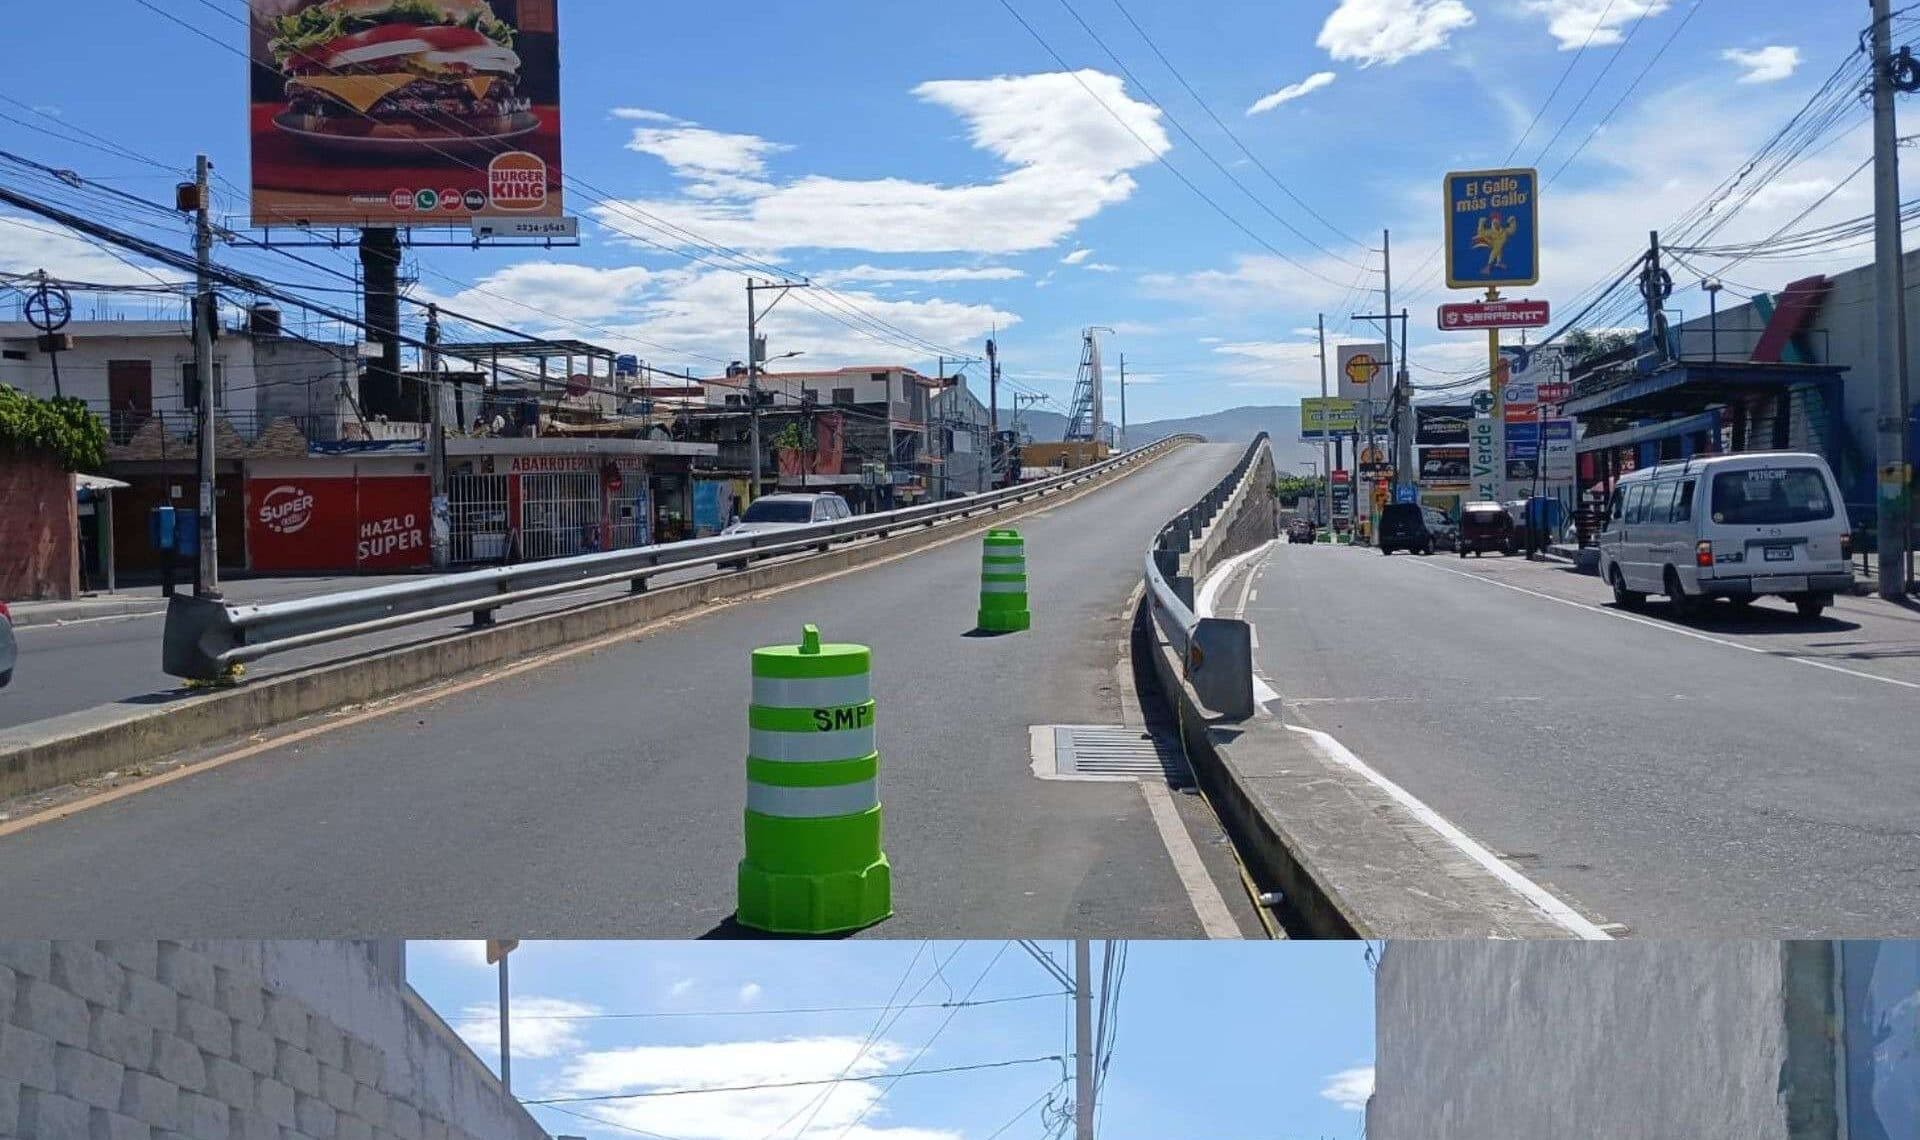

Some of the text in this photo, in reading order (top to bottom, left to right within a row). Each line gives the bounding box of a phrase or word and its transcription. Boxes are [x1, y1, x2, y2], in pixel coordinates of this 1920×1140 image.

[491, 170, 544, 183] BURGER
[1466, 177, 1518, 196] El Gallo
[492, 183, 544, 200] KING
[1455, 193, 1526, 213] más Gallo
[1471, 424, 1492, 477] Verde
[259, 495, 313, 522] SUPER
[361, 514, 415, 538] HAZLO
[358, 529, 424, 560] SUPER
[814, 705, 867, 732] SMP
